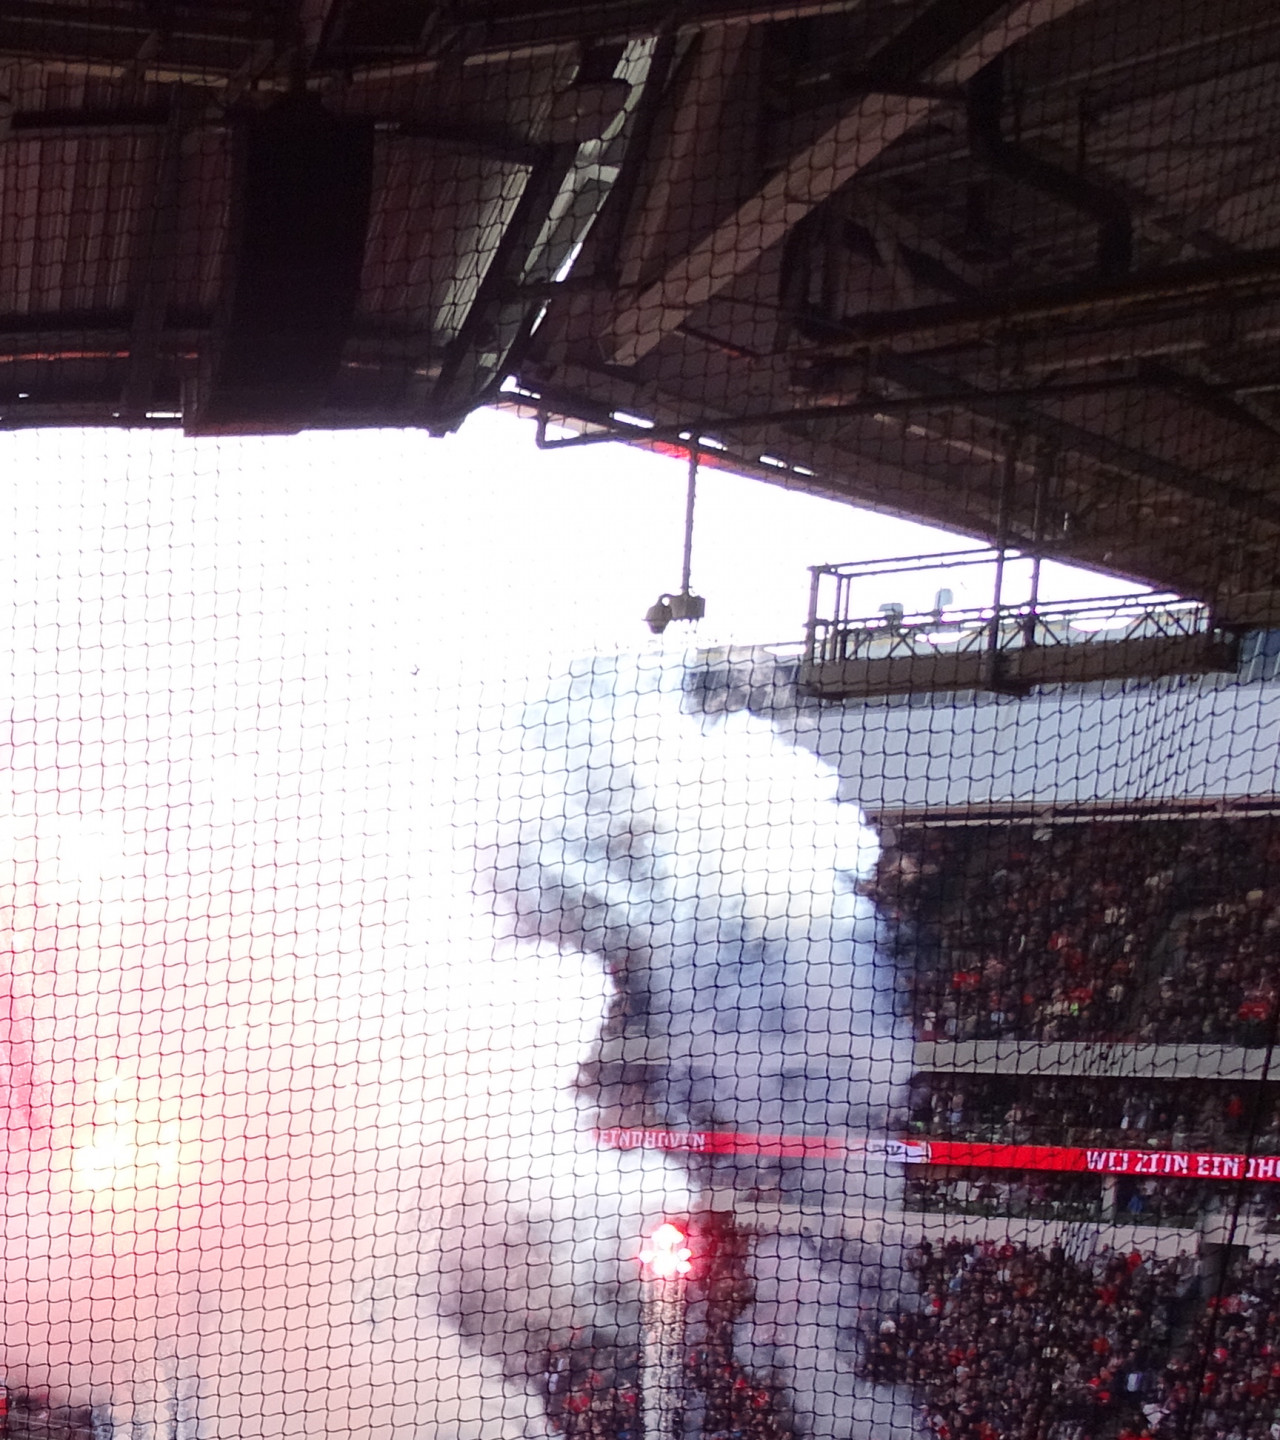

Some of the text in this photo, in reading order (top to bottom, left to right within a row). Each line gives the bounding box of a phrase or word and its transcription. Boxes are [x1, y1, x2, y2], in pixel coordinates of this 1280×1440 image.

[600, 1129, 705, 1151] EINDHOVEN
[1087, 1151, 1129, 1171] WIJ
[1134, 1153, 1189, 1175] ZIJN
